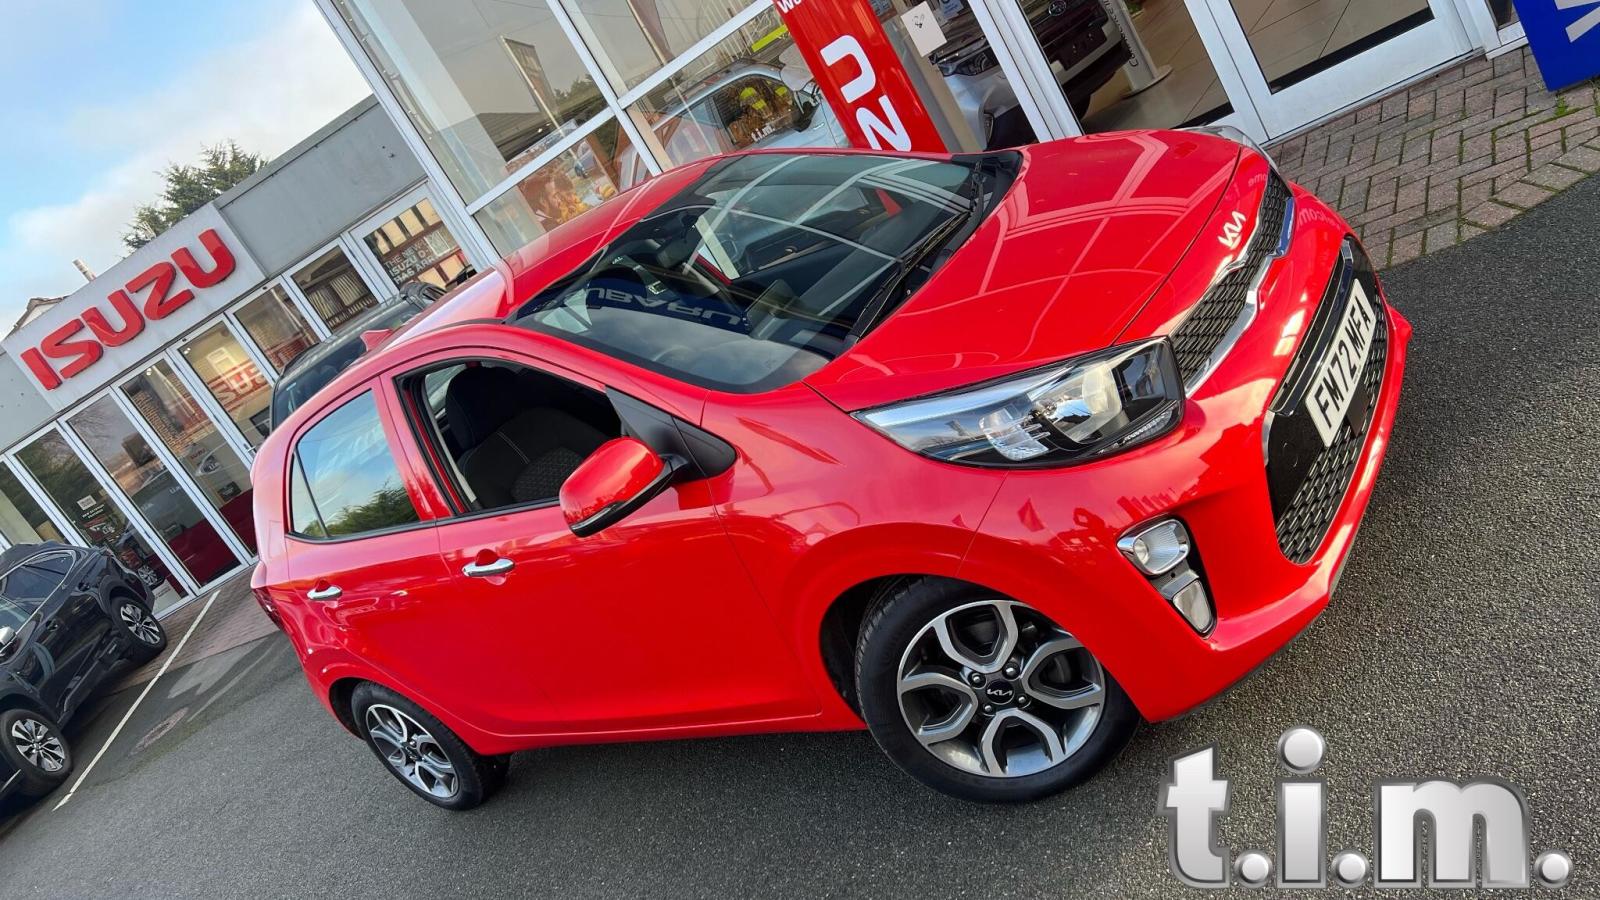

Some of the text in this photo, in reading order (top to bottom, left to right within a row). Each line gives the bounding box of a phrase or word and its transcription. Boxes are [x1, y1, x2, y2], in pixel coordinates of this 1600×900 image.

[384, 254, 401, 268] THE
[389, 257, 417, 276] ISUZU
[20, 228, 237, 391] ISUZU
[1313, 295, 1371, 429] FM72 MFA
